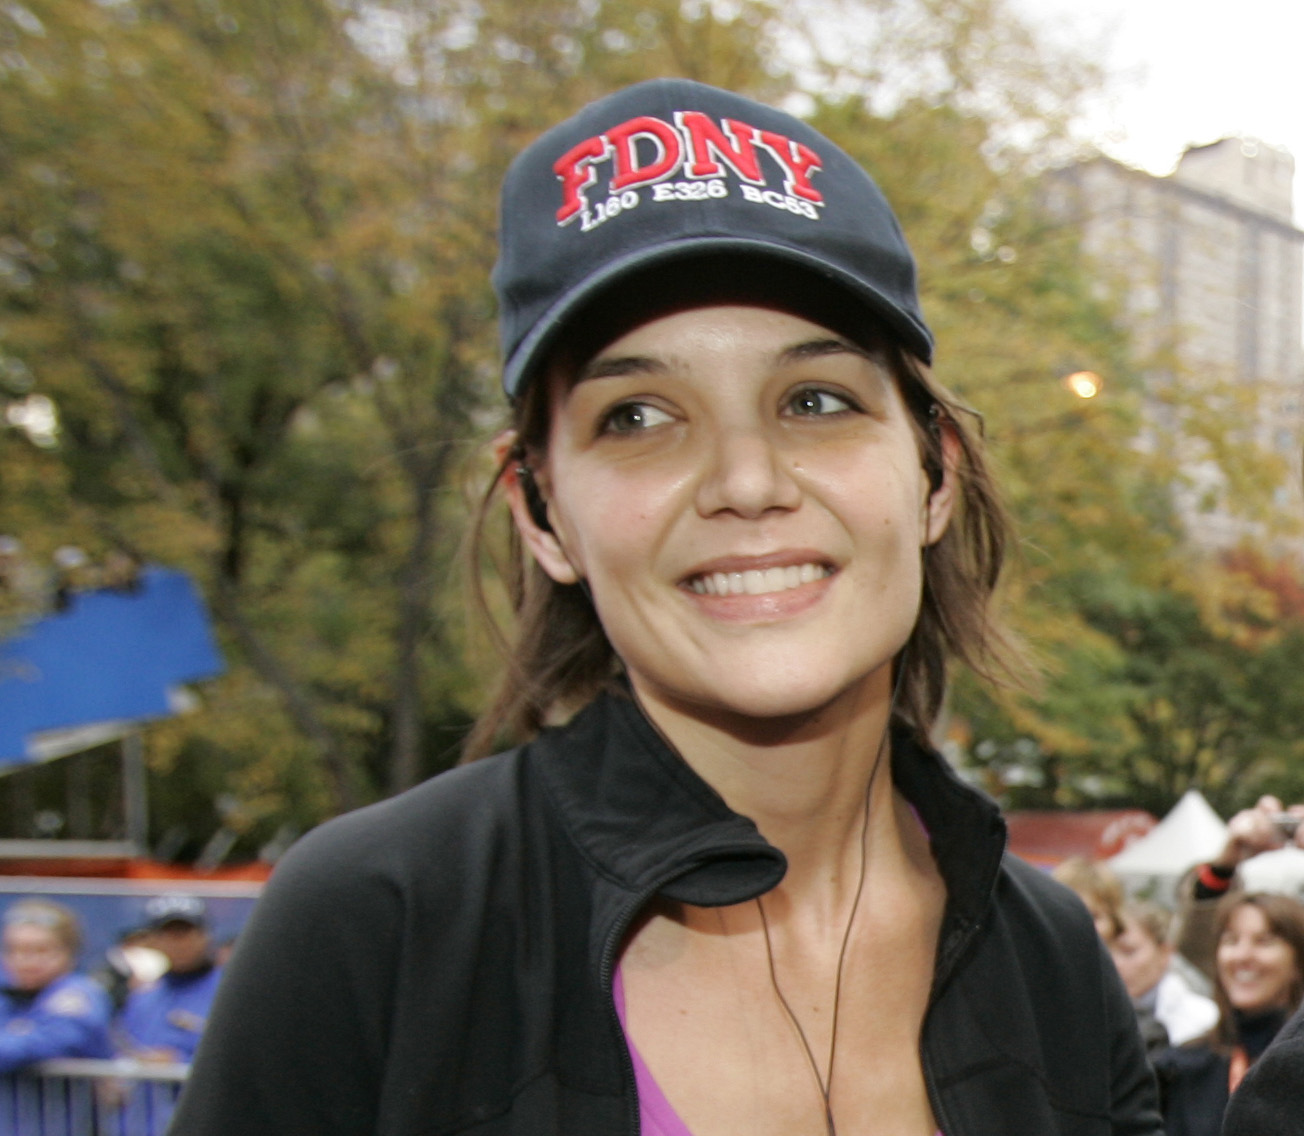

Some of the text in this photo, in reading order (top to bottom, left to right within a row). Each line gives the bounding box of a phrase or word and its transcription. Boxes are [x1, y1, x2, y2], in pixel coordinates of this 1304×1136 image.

[553, 111, 825, 227] FDNY
[580, 191, 640, 232] L160
[651, 179, 729, 202] E326
